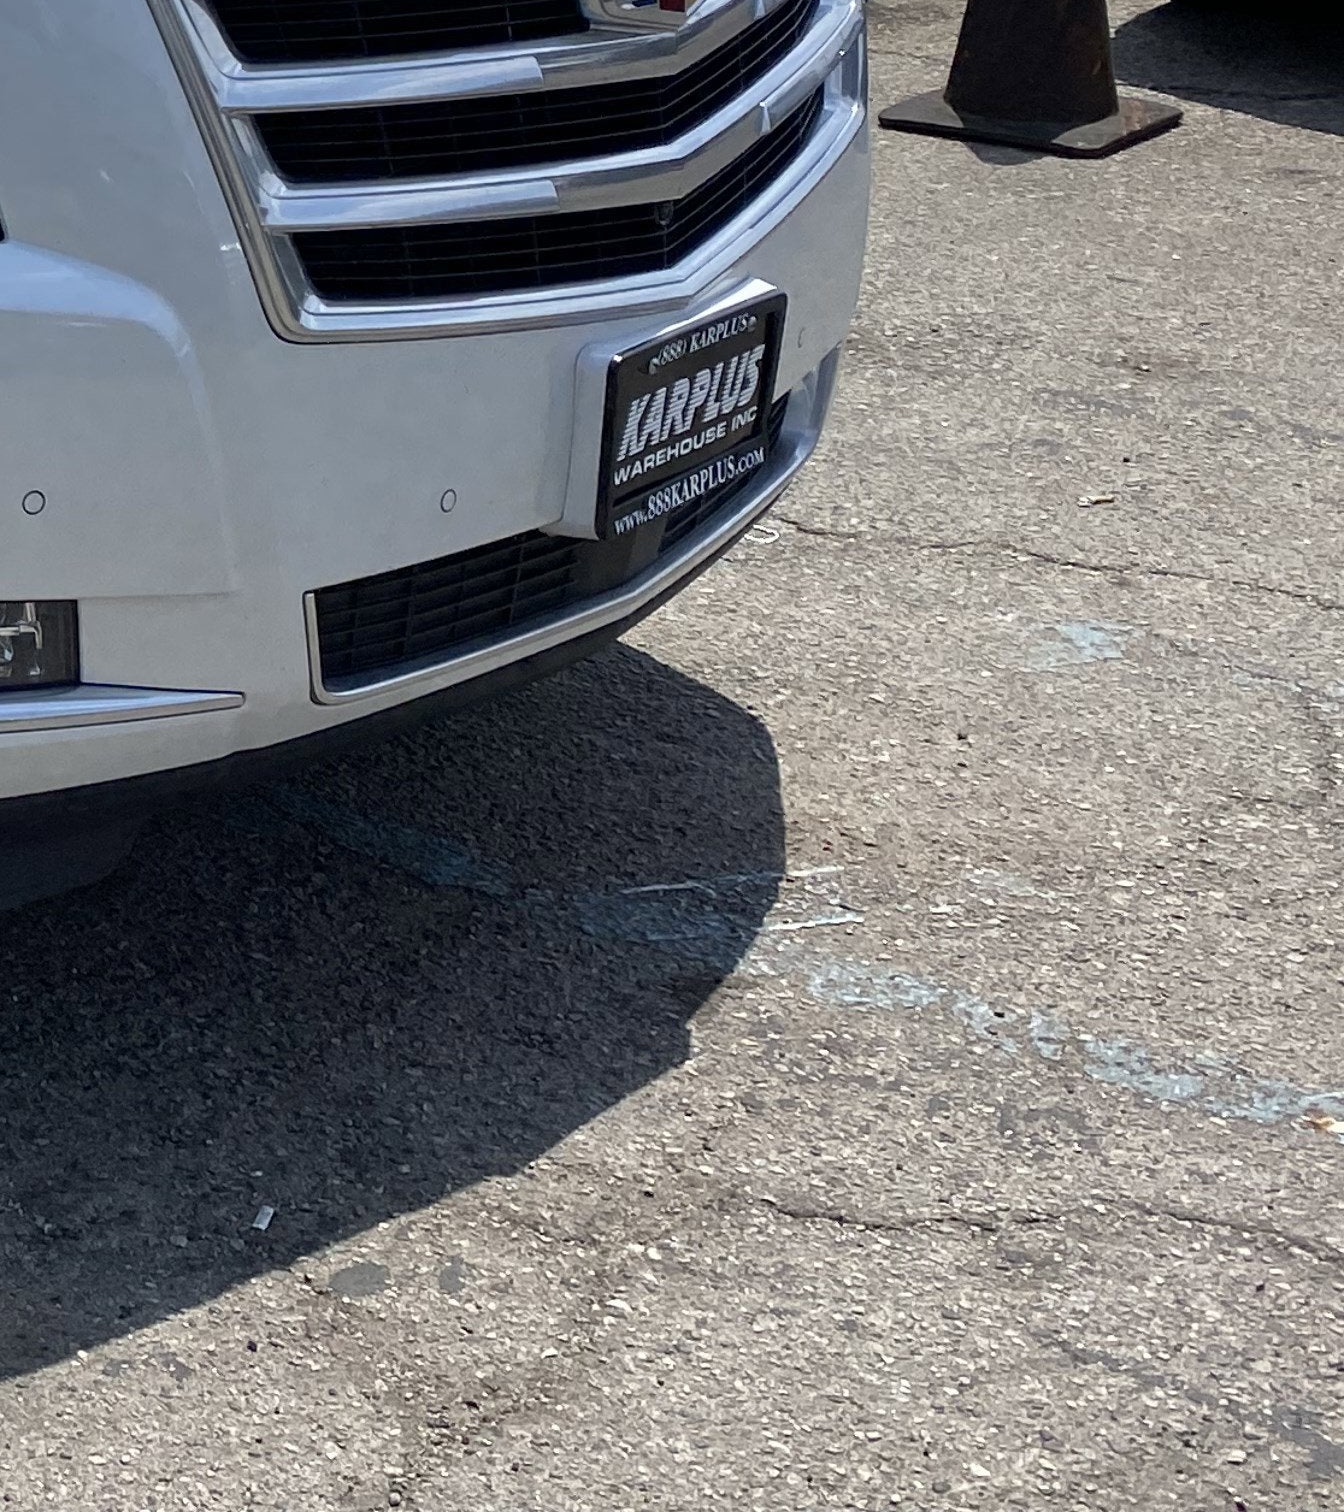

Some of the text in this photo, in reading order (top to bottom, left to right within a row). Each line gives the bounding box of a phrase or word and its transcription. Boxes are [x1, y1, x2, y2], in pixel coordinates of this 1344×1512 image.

[689, 312, 749, 354] KARPLUS
[616, 344, 765, 462] KARPLUS
[614, 421, 728, 486] WAREHOUSE
